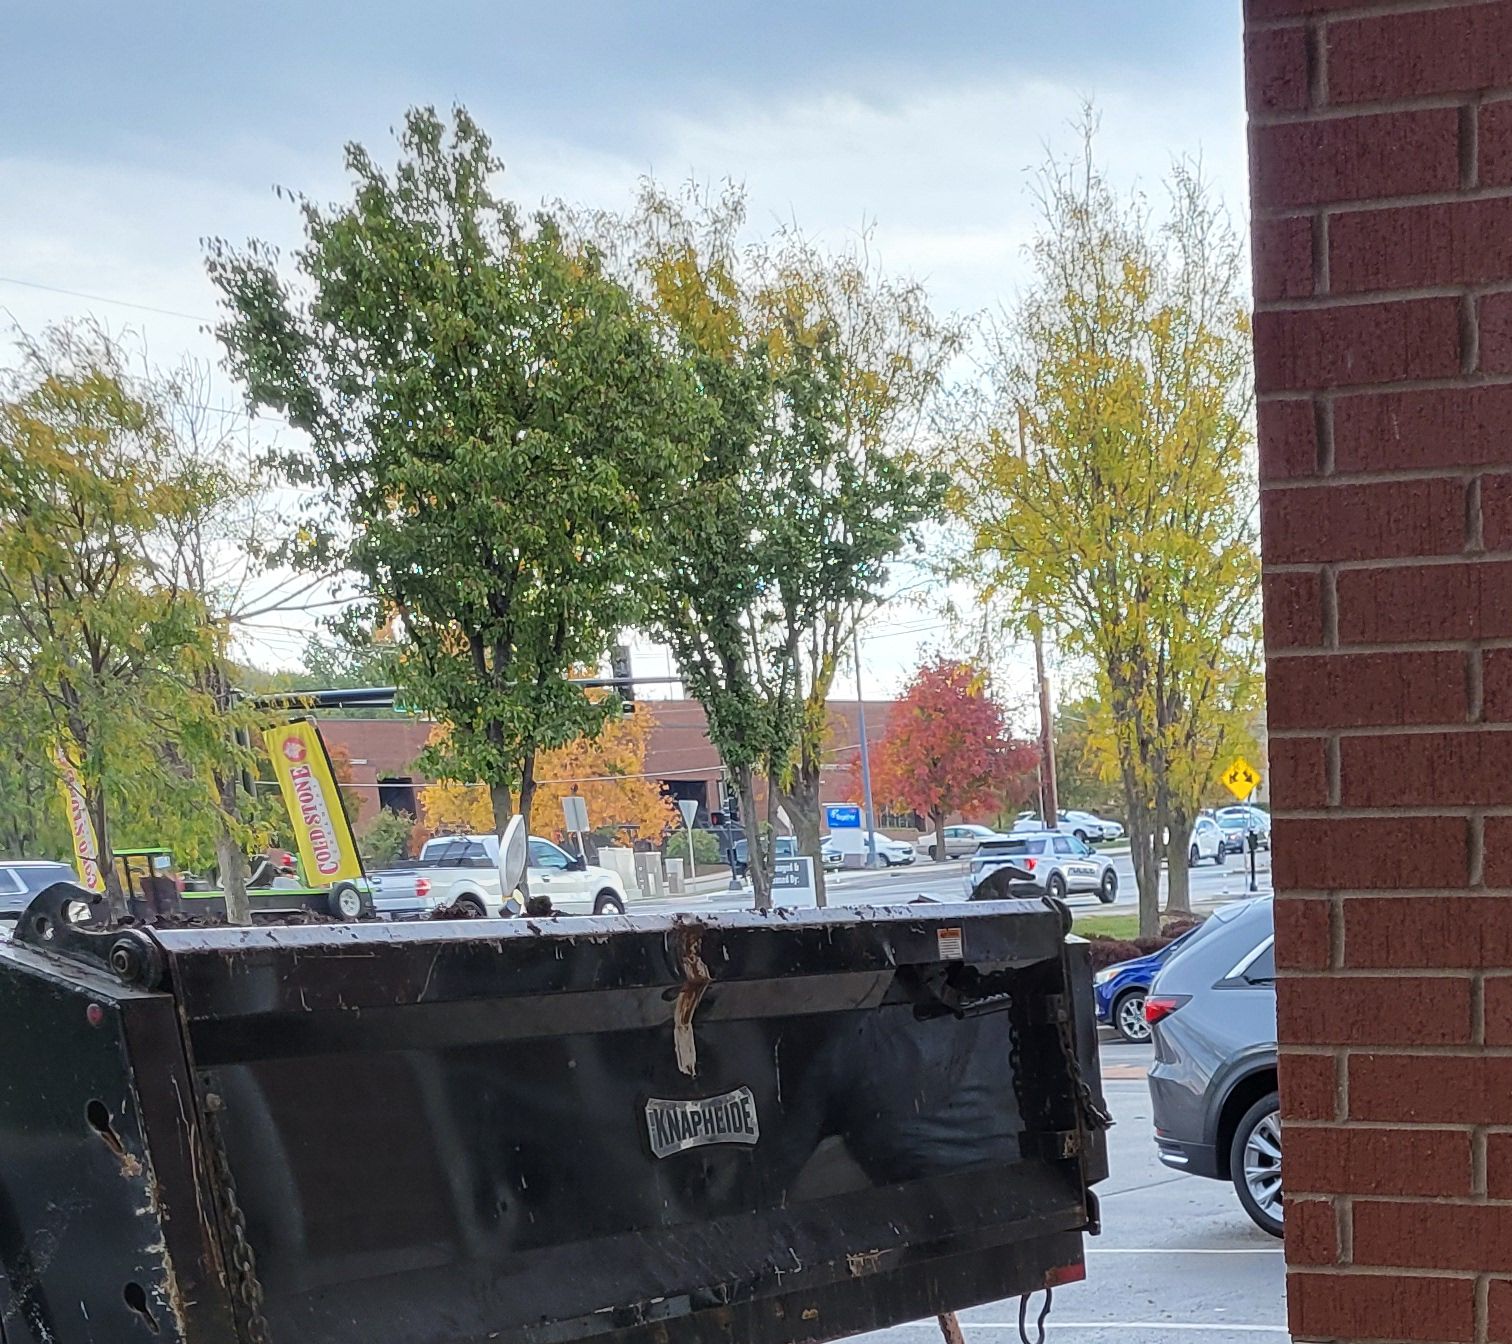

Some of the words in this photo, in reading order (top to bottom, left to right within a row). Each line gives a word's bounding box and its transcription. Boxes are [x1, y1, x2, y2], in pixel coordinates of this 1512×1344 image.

[290, 765, 321, 826] STONE
[309, 829, 339, 874] COLD
[653, 1096, 755, 1148] KNAPHEIDE
